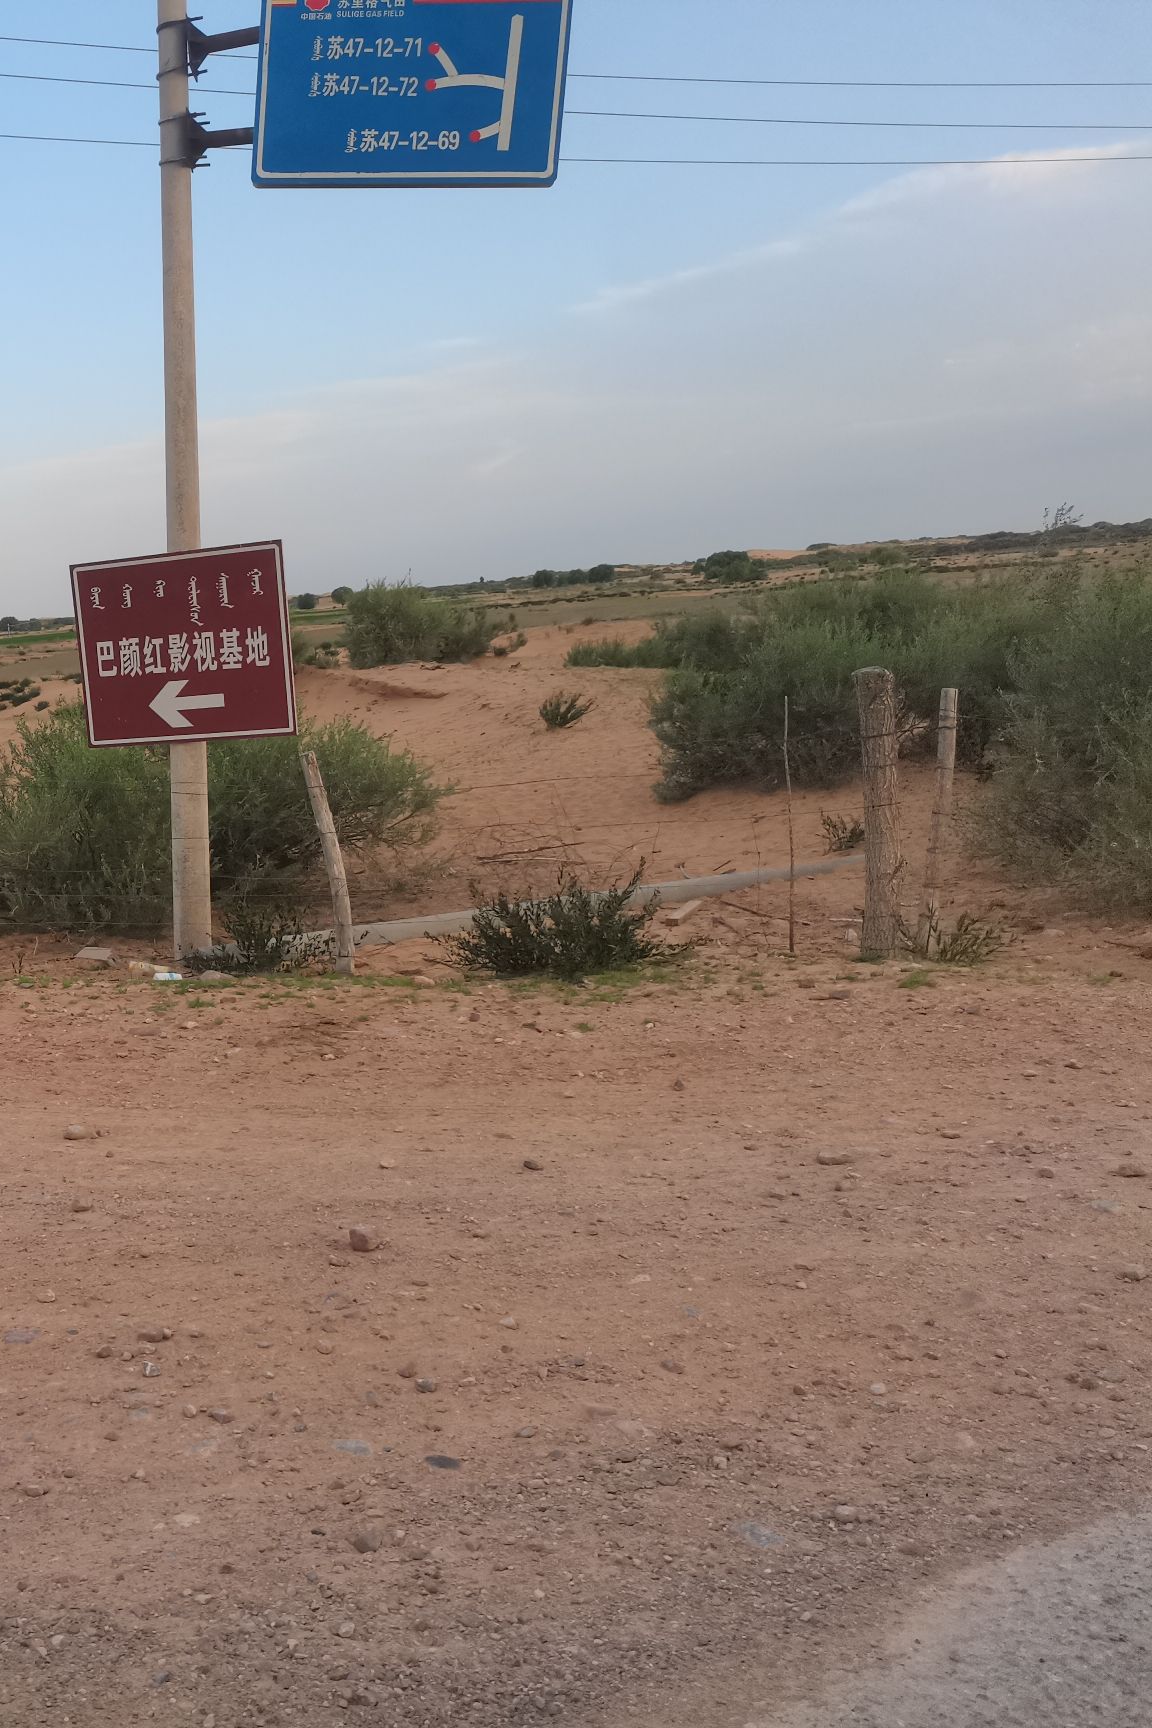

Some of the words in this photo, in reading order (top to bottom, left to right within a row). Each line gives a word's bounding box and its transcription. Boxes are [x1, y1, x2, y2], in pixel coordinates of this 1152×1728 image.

[300, 12, 332, 21] 中国石油
[336, 10, 364, 18] SULIGE
[365, 10, 382, 18] GAS
[383, 9, 405, 17] FIELD
[96, 626, 271, 677] 巴颜红影视基地
